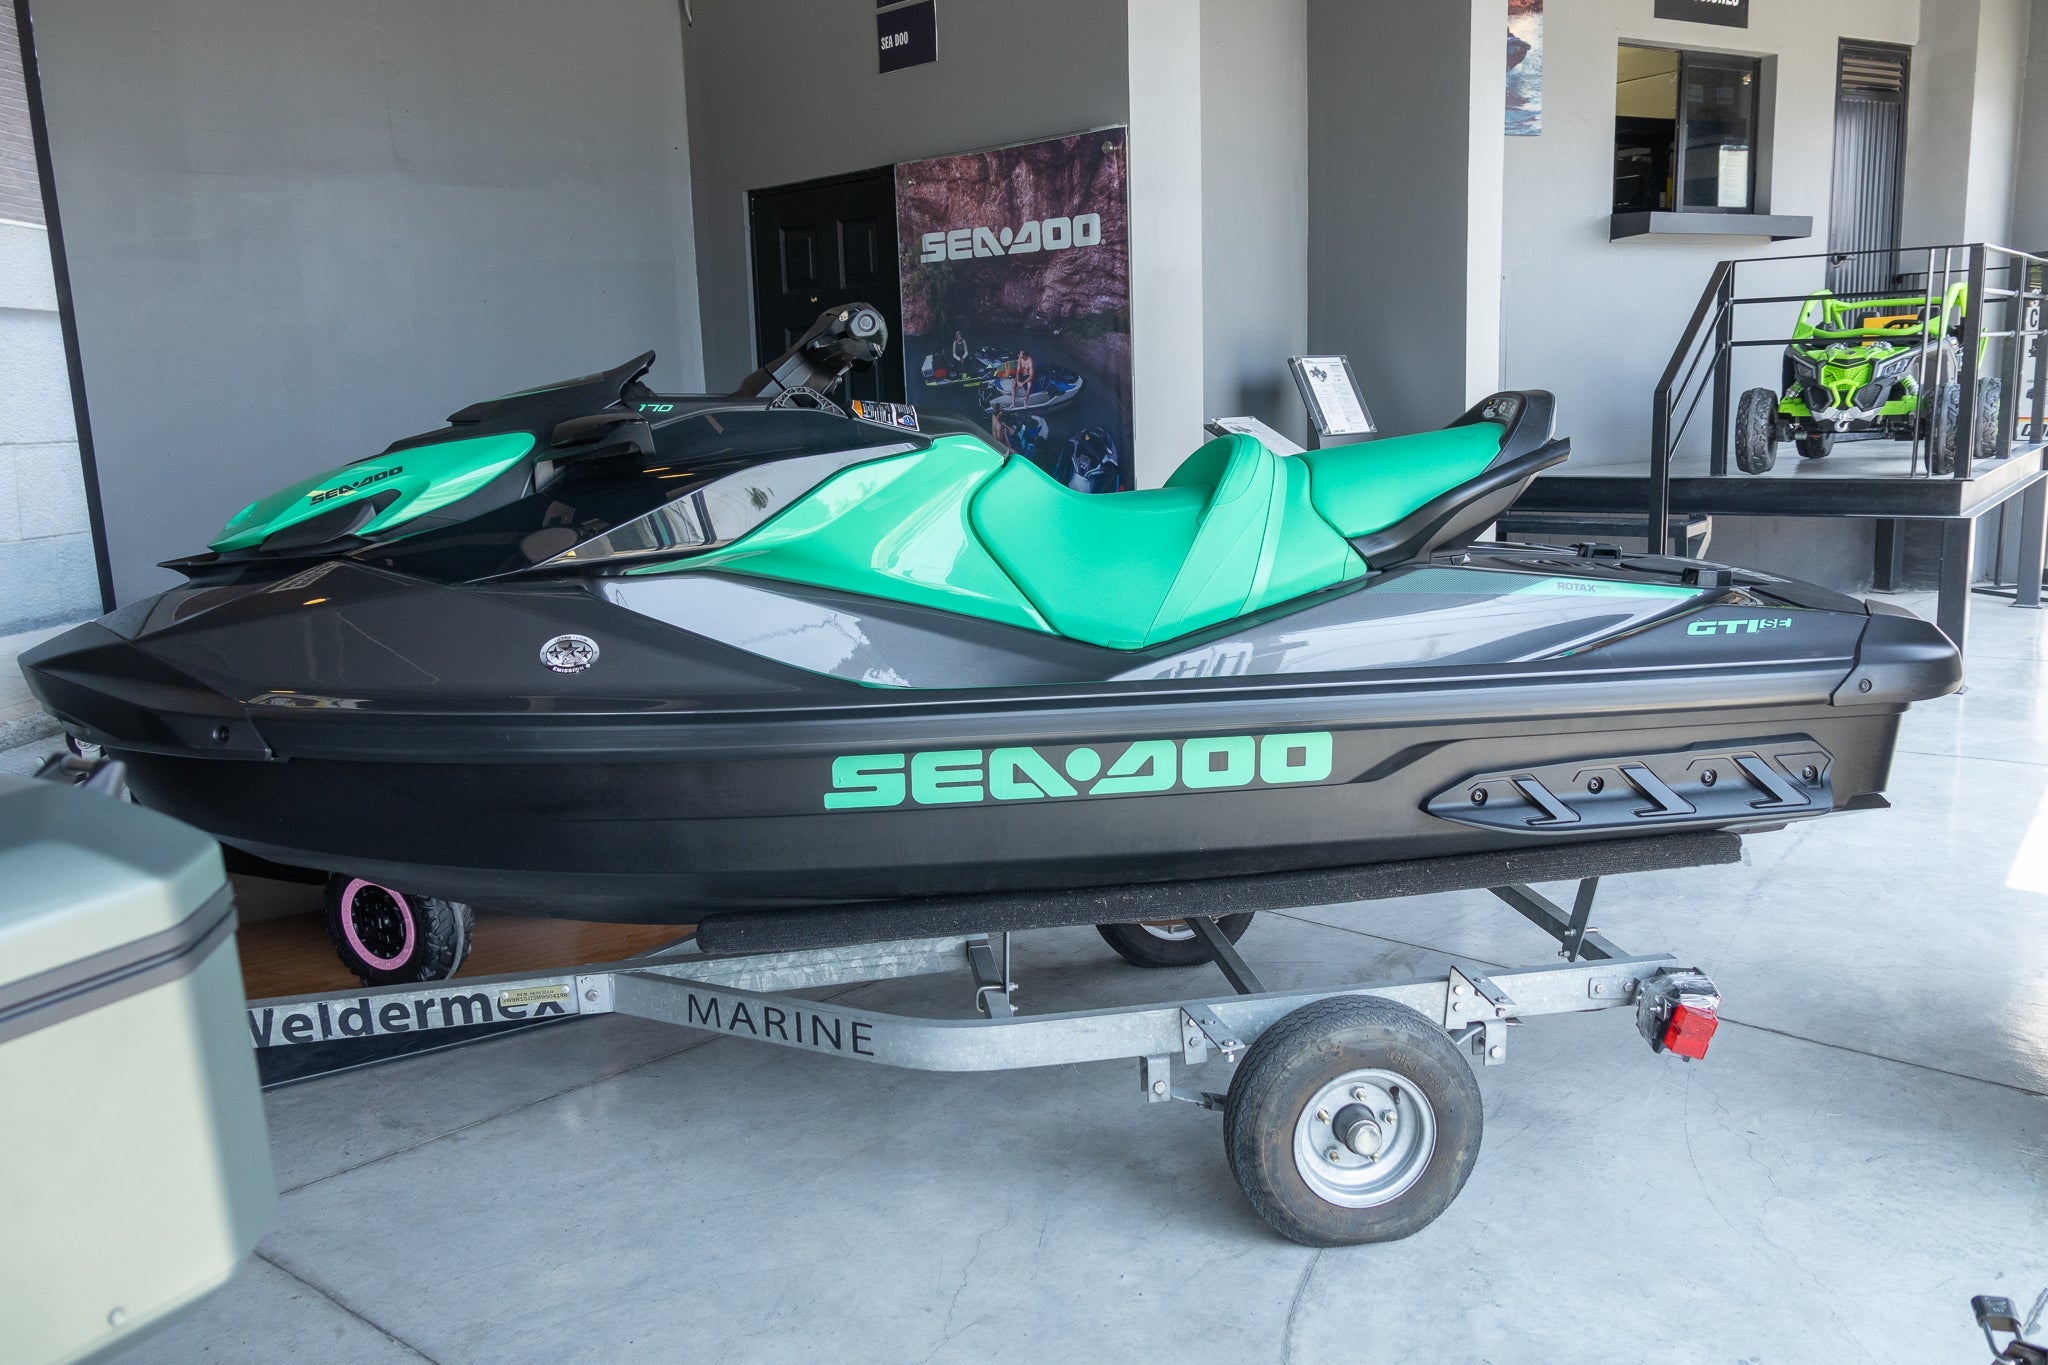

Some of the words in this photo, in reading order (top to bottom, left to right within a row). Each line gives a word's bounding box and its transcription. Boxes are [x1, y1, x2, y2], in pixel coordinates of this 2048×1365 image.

[880, 35, 894, 50] SEA
[894, 31, 909, 47] DOO
[638, 403, 674, 412] 170
[1556, 581, 1596, 592] ROTAX
[687, 993, 875, 1057] MARINE
